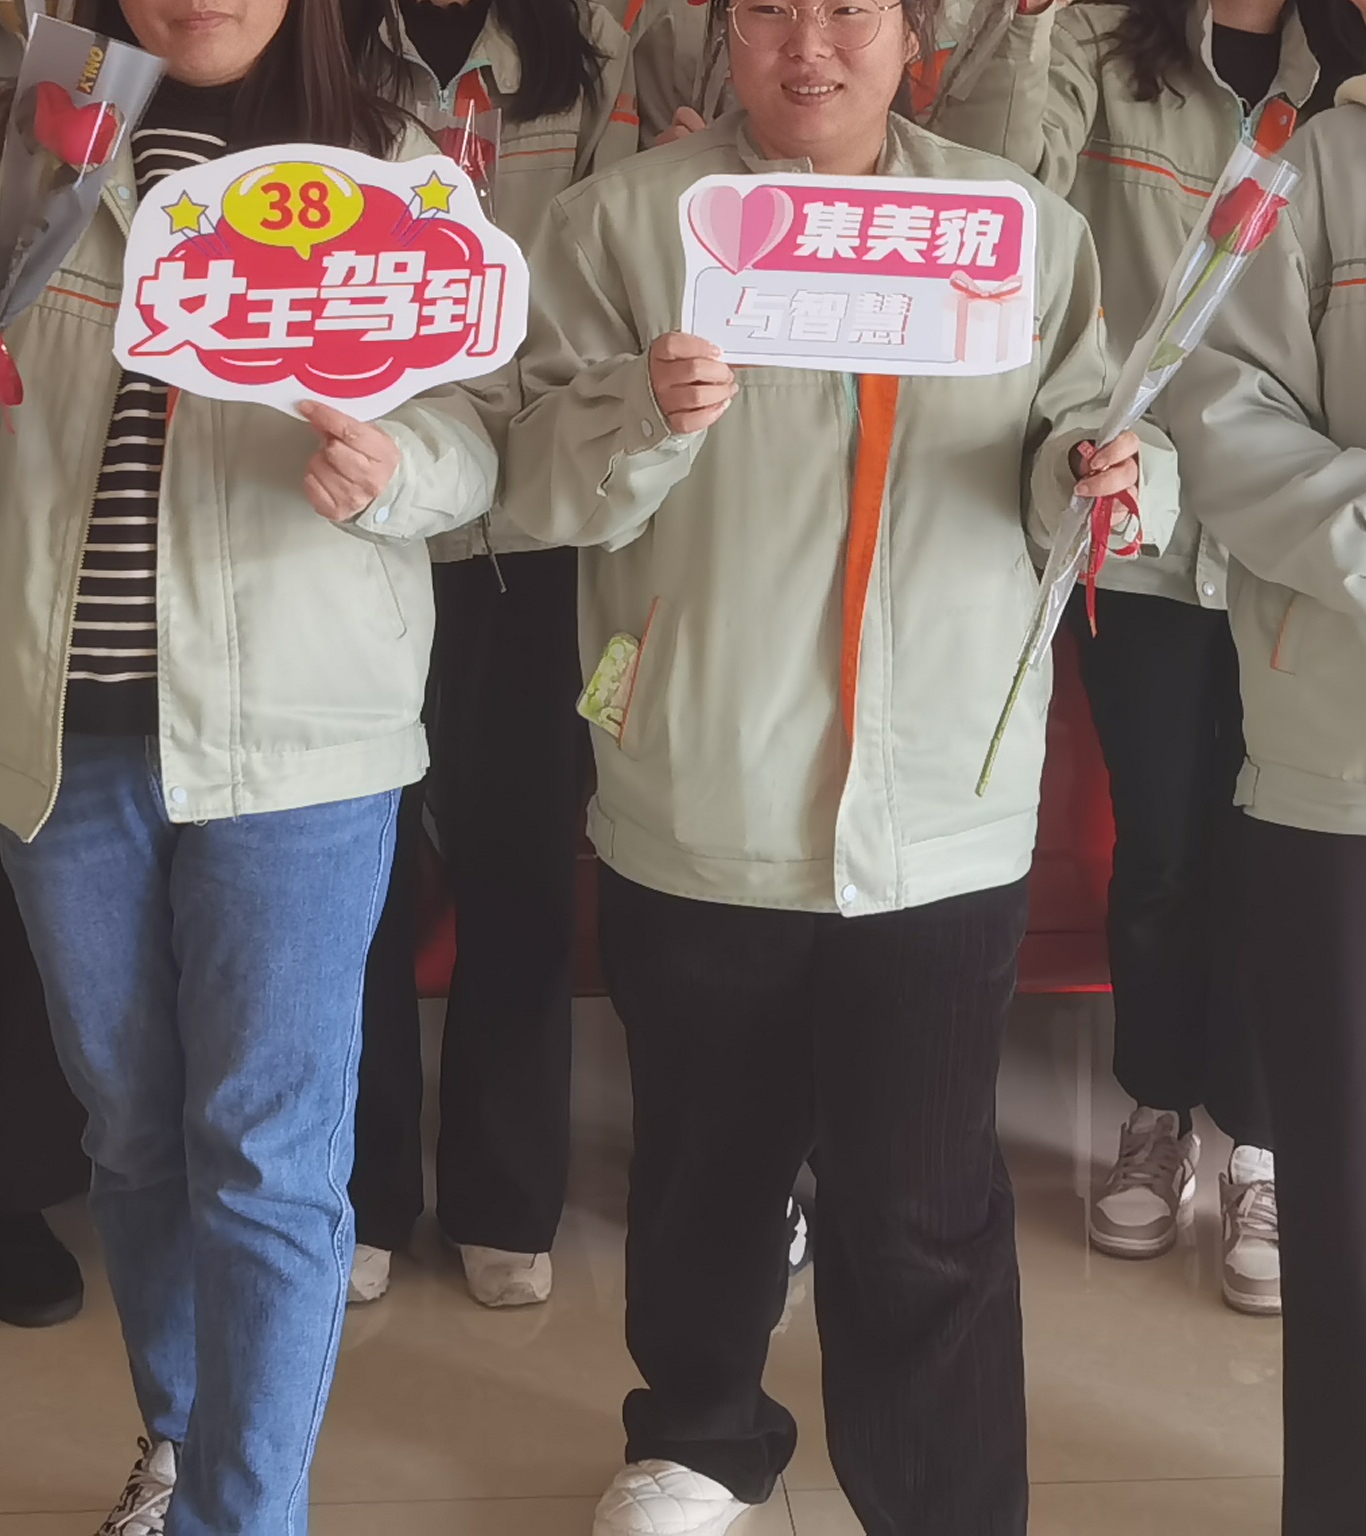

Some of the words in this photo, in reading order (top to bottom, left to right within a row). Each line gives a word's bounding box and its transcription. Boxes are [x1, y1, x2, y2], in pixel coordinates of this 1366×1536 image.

[260, 181, 332, 231] 38
[794, 201, 1005, 267] 集美貌
[130, 250, 503, 356] 女王驾到
[726, 285, 915, 347] 与智慧
